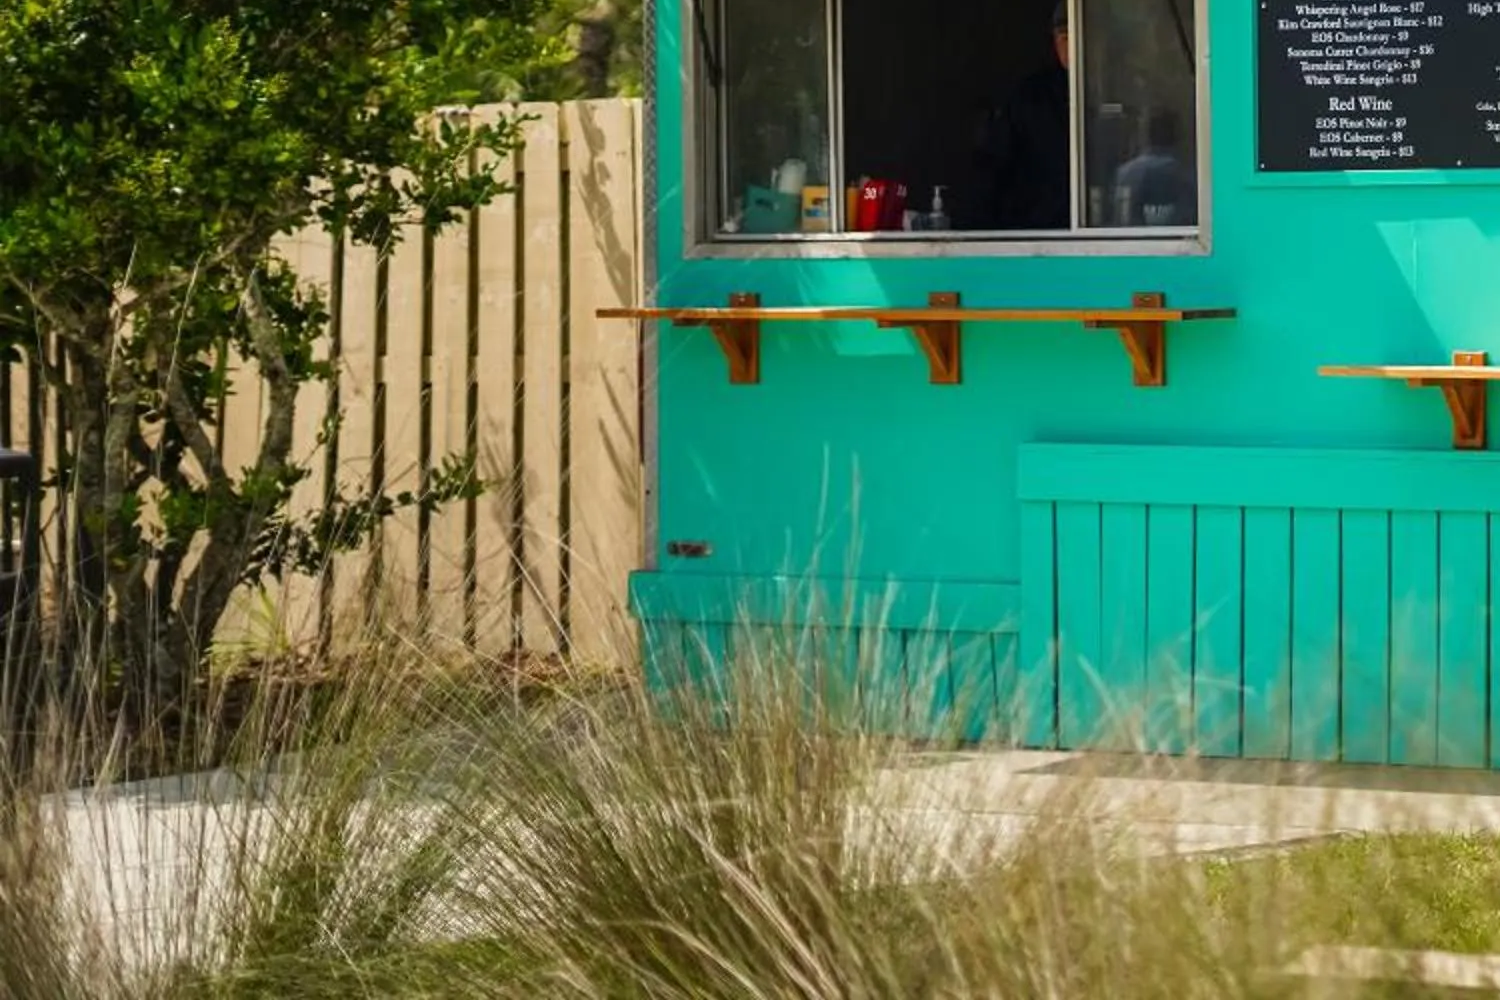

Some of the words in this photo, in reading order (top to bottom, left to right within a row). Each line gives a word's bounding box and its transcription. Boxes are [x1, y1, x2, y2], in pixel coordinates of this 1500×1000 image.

[1296, 4, 1348, 17] Whispering
[1351, 4, 1376, 15] Angel
[1468, 3, 1492, 16] High
[1301, 18, 1341, 29] Crawford
[1344, 18, 1390, 30] Sauvignon
[1393, 17, 1419, 26] Blanc
[1335, 31, 1389, 43] Chardonnay
[1288, 48, 1323, 57] Sonoma
[1360, 74, 1394, 87] Sangria
[1329, 98, 1355, 110] Red
[1358, 96, 1392, 110] Wine
[1366, 118, 1387, 127] Noir
[1343, 132, 1384, 142] Cabernet
